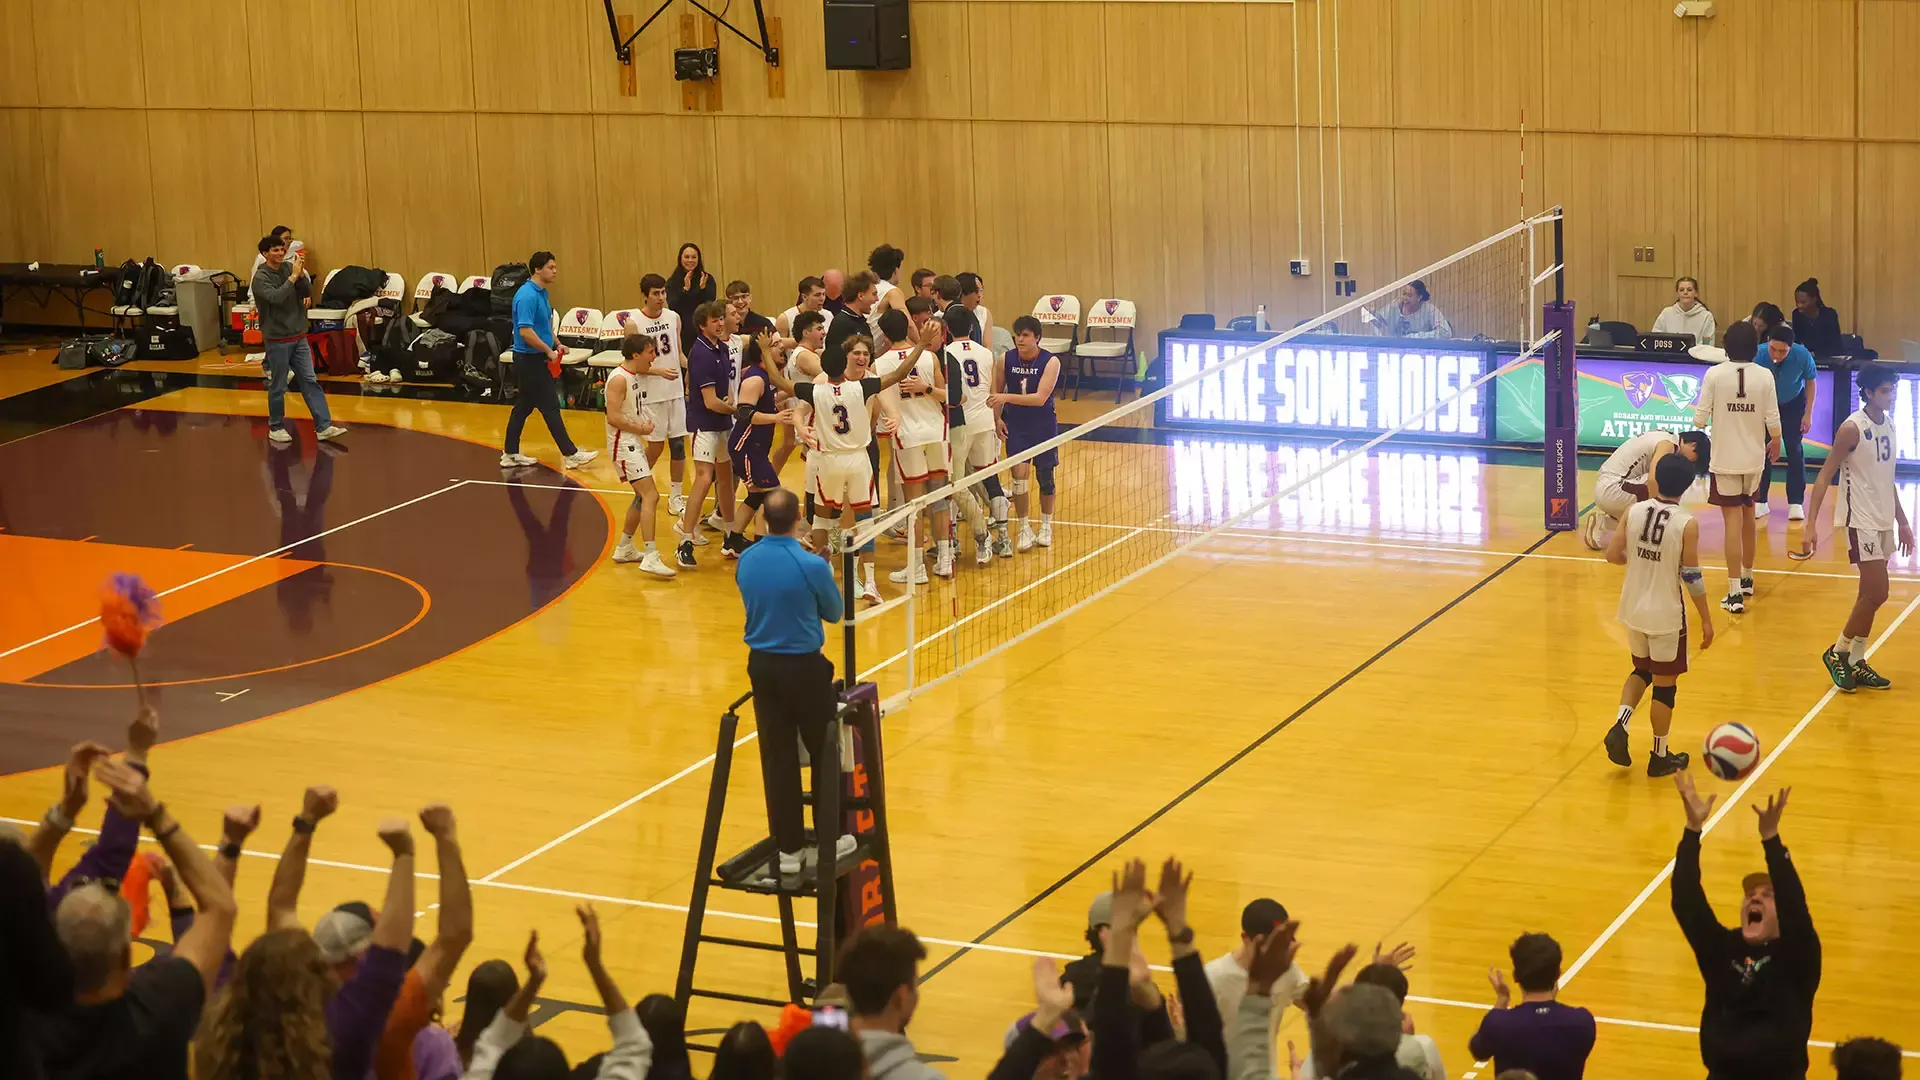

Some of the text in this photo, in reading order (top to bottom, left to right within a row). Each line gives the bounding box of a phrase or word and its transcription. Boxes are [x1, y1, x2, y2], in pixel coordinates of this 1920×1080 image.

[1033, 312, 1077, 321] STATESMEN
[1088, 316, 1133, 324] STATESMEN
[560, 325, 599, 335] STATESMEN
[601, 329, 625, 337] STATE
[1654, 339, 1673, 350] poss
[963, 358, 980, 387] 9
[1011, 366, 1039, 375] HOBART
[1172, 343, 1267, 422] MAKE
[1275, 348, 1369, 428] SOME
[1377, 352, 1480, 433] NOISE
[1735, 367, 1747, 398] 1
[1726, 403, 1756, 413] VASSAR
[832, 404, 850, 435] 3
[1613, 412, 1640, 420] HOBART
[1640, 413, 1654, 421] AND
[1655, 414, 1683, 422] WILLIAM
[1874, 435, 1891, 462] 13
[1556, 439, 1564, 494] sports imports
[1640, 506, 1670, 545] 16
